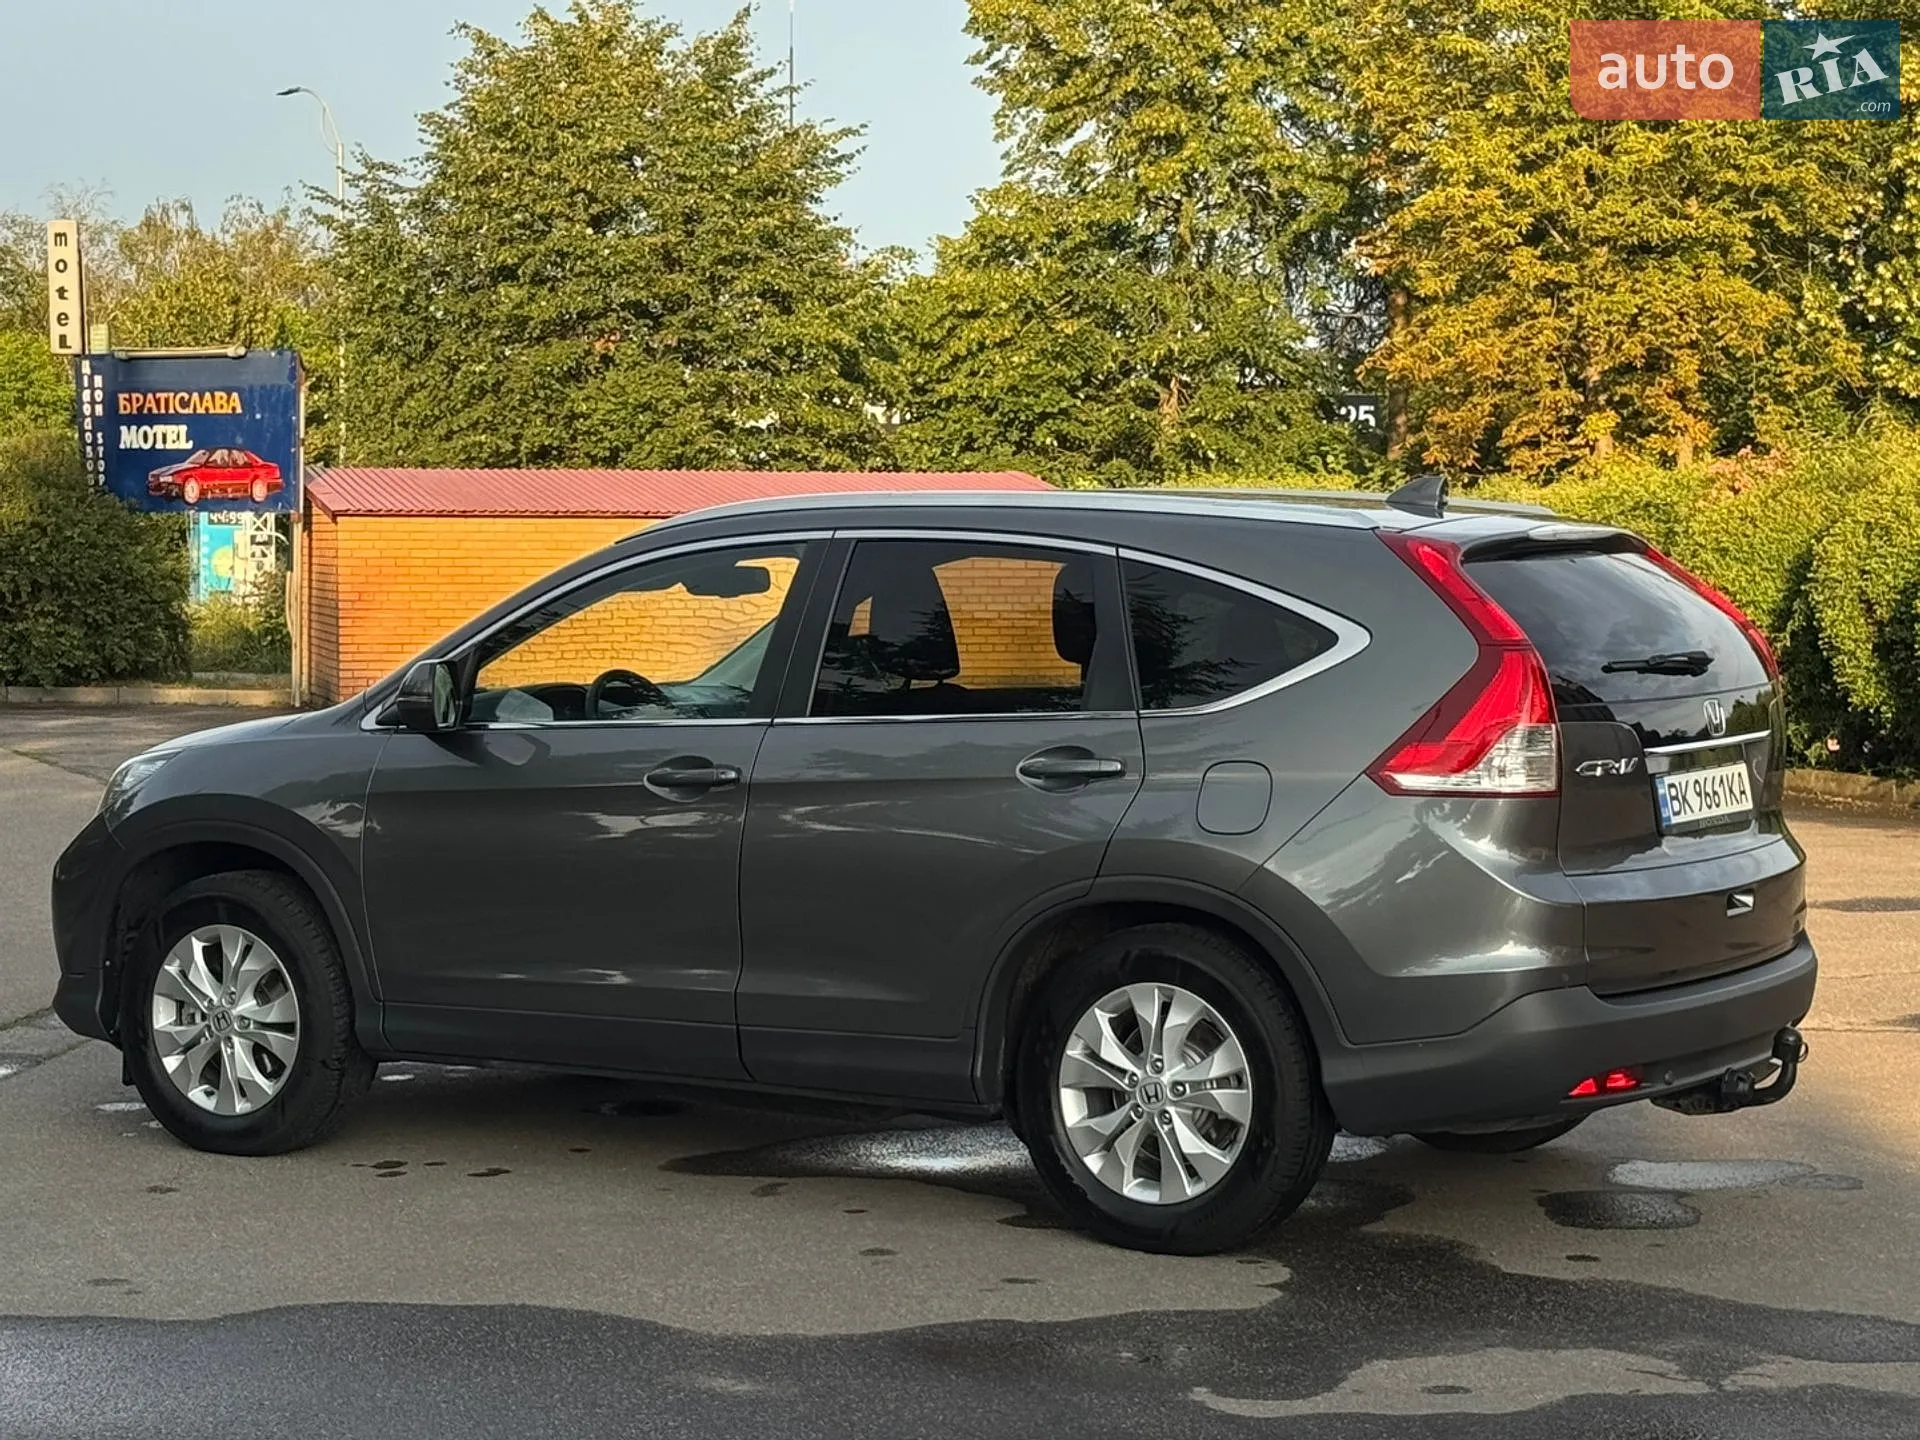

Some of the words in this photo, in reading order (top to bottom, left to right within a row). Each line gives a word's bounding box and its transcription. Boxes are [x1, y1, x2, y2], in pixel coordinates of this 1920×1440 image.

[117, 391, 243, 415] БРАТІСЛАВА
[119, 424, 194, 450] MOTEL
[97, 431, 105, 486] STOP
